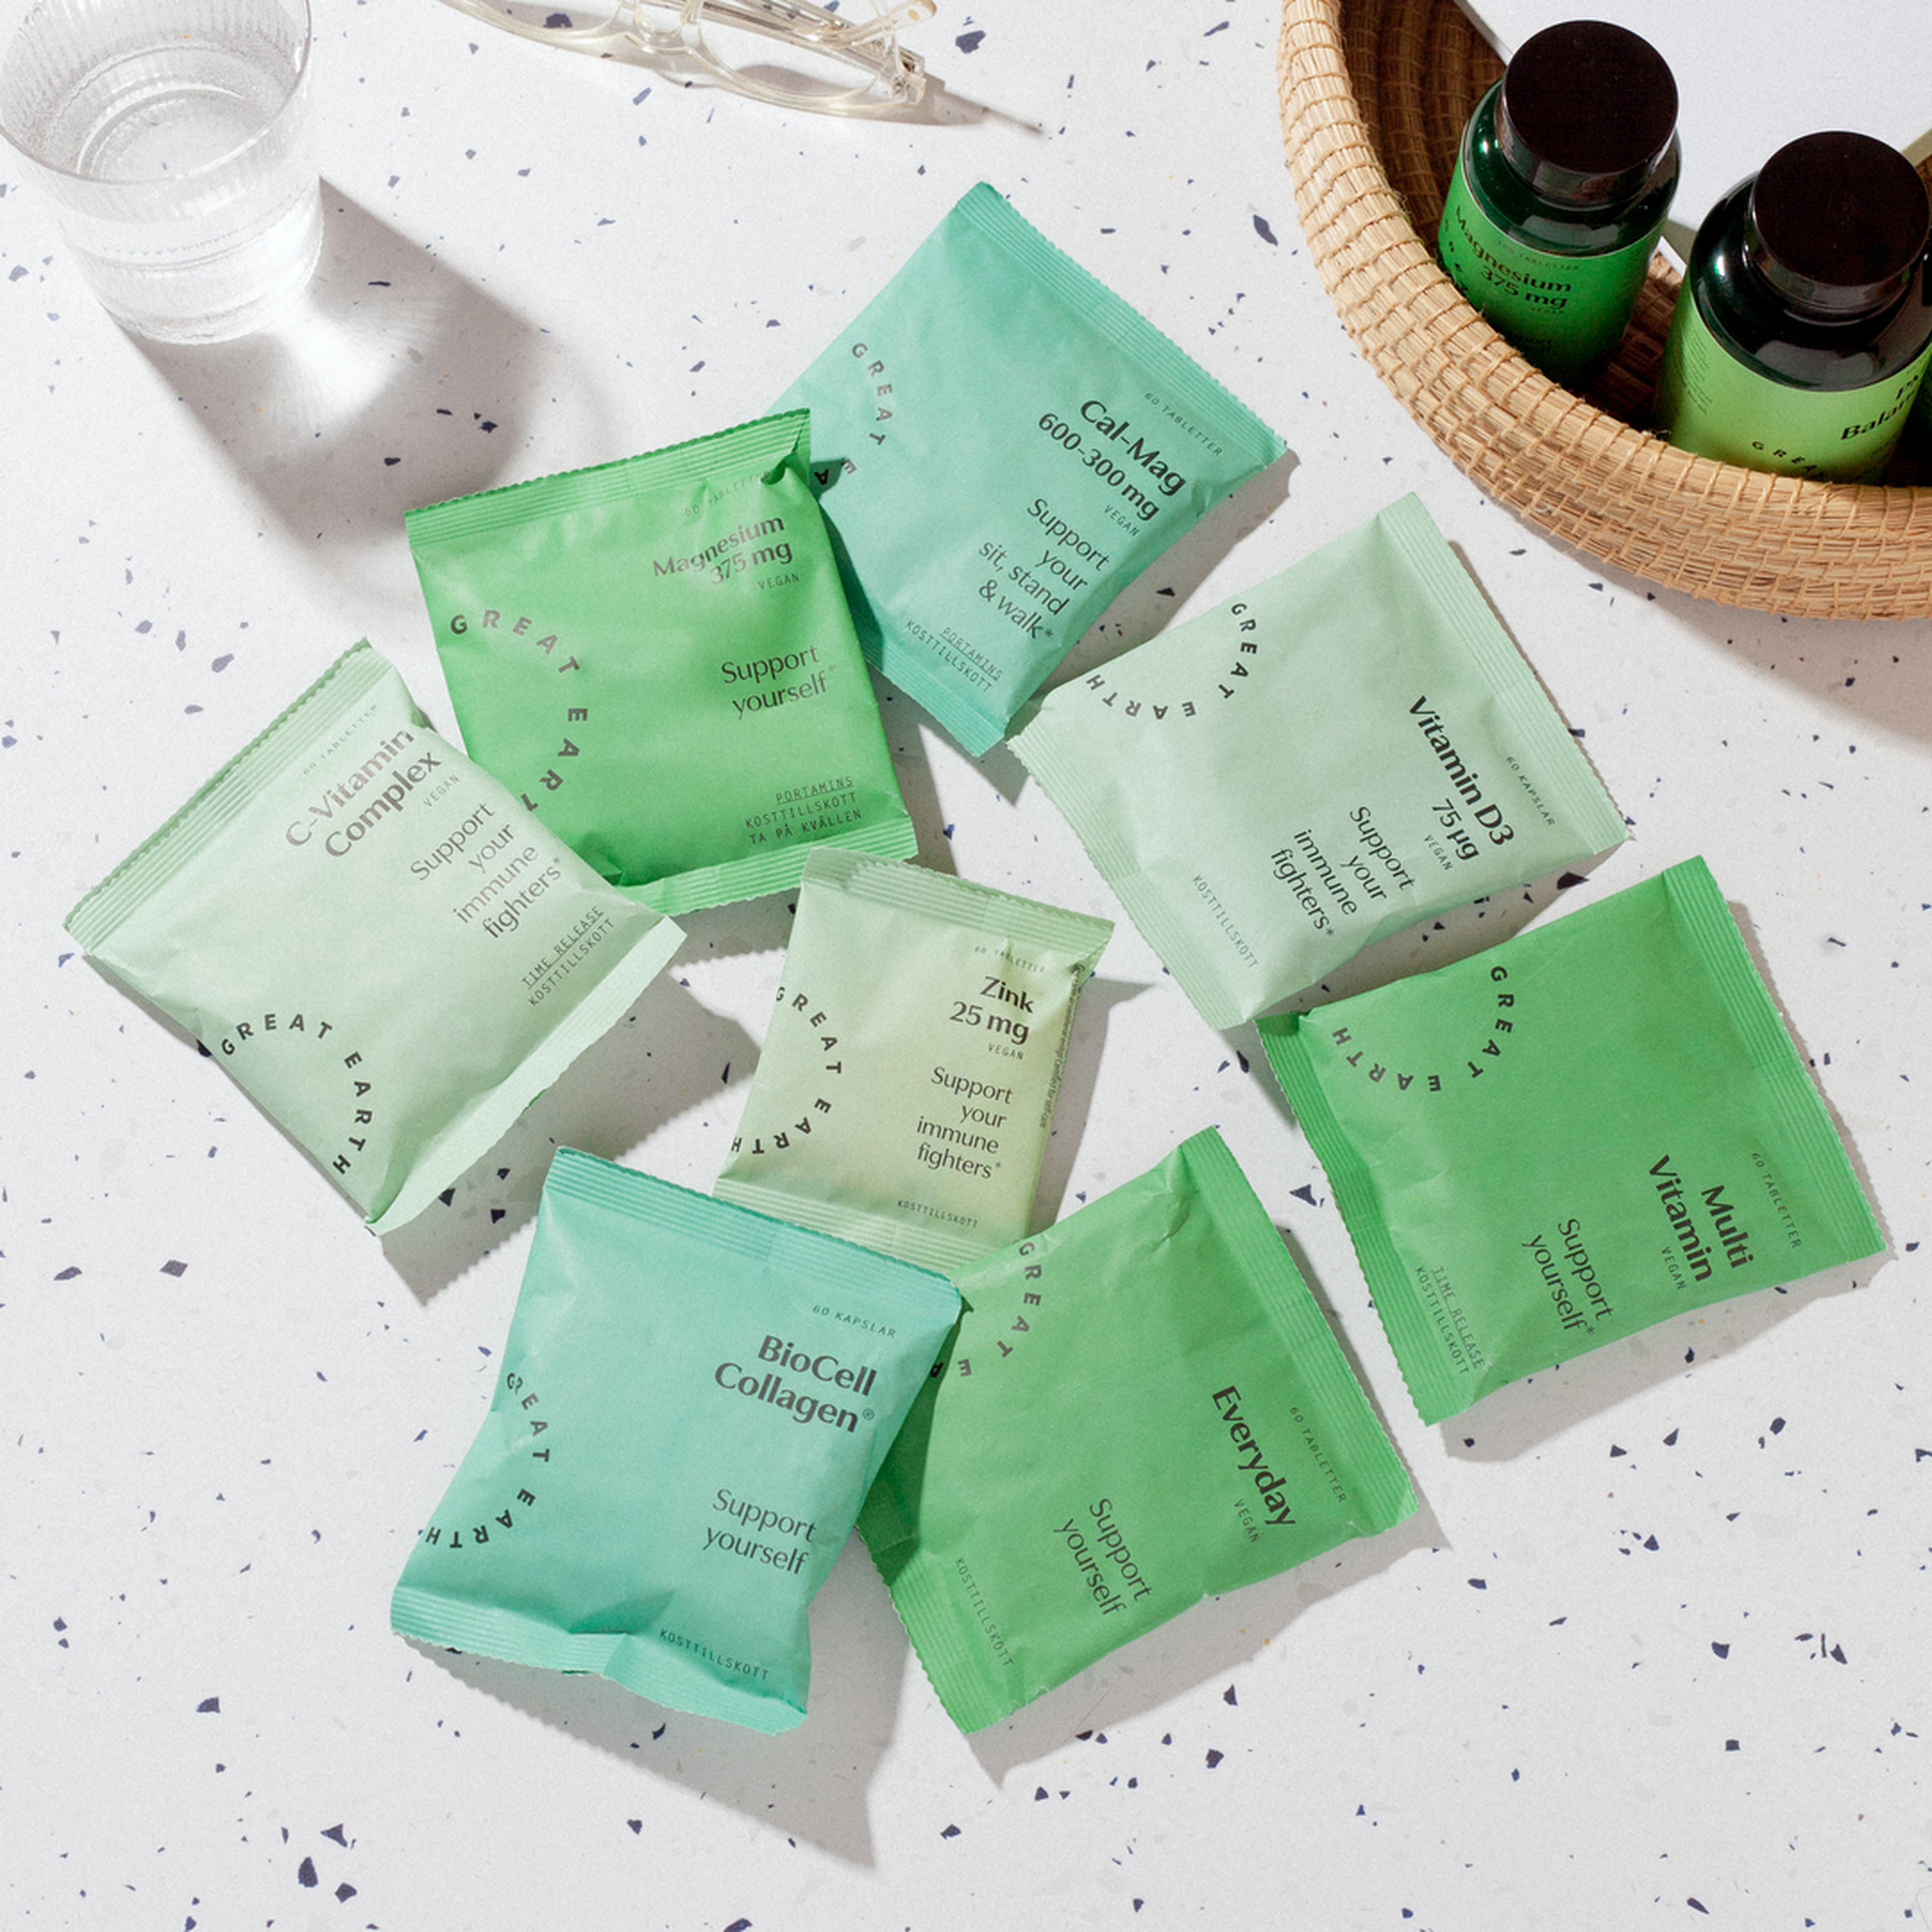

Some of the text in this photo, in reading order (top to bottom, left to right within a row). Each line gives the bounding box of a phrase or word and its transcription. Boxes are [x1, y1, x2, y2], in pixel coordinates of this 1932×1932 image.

[1456, 205, 1572, 292] Magnesium
[1481, 265, 1567, 309] 375 mg
[852, 343, 893, 445] GREAT
[1145, 393, 1223, 456] 60 TABLETTER
[1038, 413, 1159, 521] 600-300 mg
[1081, 400, 1186, 496] Cal-Mag
[1752, 441, 1817, 472] GREA
[685, 505, 700, 516] 60
[1027, 499, 1110, 571] Support
[1104, 505, 1140, 537] VEGAN
[653, 517, 784, 576] Magnesium
[710, 542, 793, 585] 375 mg
[1035, 550, 1088, 590] your
[758, 573, 799, 590] VEGAN
[979, 541, 1070, 615] sit, stand
[979, 579, 998, 601] &
[451, 610, 580, 673] GREAT
[721, 645, 820, 683] Support
[906, 621, 993, 693] KOSTTILLSKOTT
[940, 627, 1004, 681] PORTAMINS
[1218, 603, 1257, 699] GREAT
[1086, 674, 1196, 719] EARTH
[321, 704, 377, 759] TABLETTER
[521, 708, 587, 811] EART
[286, 730, 414, 845] C-Vitamin
[423, 774, 460, 807] VEGAN
[776, 776, 854, 805] PORTAMINS
[1409, 695, 1514, 845] Vitamin D3
[1506, 756, 1555, 826] 60 KAPSLAR
[326, 752, 441, 856] Complex
[746, 792, 856, 829] KOSTTILLSKOTT
[749, 809, 861, 844] TA PÅ KVÄLLEN
[1432, 798, 1480, 860] 75 µg
[410, 802, 496, 880] Support
[469, 825, 514, 873] your
[1294, 829, 1357, 915] immune
[1350, 806, 1415, 891] Support
[1424, 835, 1453, 870] VEGAN
[453, 846, 539, 923] immune
[1340, 855, 1387, 900] your
[521, 907, 604, 990] TIME RELEASE
[1193, 874, 1259, 969] KOSTTILLSKOTT
[528, 918, 614, 1006] KOSTTILLSKOTT
[950, 1001, 1029, 1045] 25 mg
[980, 976, 1034, 1013] Zink
[1468, 966, 1514, 1078] GREAT
[222, 1014, 333, 1055] GREAT
[776, 987, 842, 1074] GREAT
[988, 1042, 1023, 1060] VEGAN
[1332, 1027, 1441, 1092] EARTH
[333, 1052, 372, 1174] EARTH
[931, 1067, 1013, 1104] Support
[960, 1105, 1007, 1128] your
[731, 1098, 832, 1154] EARTH
[917, 1116, 999, 1154] immune
[898, 1200, 978, 1228] KOSTTILLSKOTT
[1649, 1154, 1712, 1281] Vitamin
[1701, 1185, 1754, 1268] Multi
[1751, 1153, 1802, 1249] 60 TABLETTER
[1558, 1219, 1614, 1321] Support
[1661, 1246, 1686, 1290] VEGAN
[813, 1305, 896, 1338] 60 KAPSLAR
[997, 1242, 1041, 1357] GREAT
[1416, 1266, 1469, 1375] KOSTTILLSKOTT
[1431, 1267, 1485, 1370] TIME RELEASE
[758, 1335, 877, 1396] BioCell
[1213, 1386, 1296, 1525] Everyday
[1290, 1407, 1347, 1503] 60 TABLETTER
[426, 1489, 535, 1548] EARTH
[713, 1489, 817, 1543] Support
[1235, 1498, 1260, 1543] VEGAN
[703, 1527, 809, 1574] yourself
[1054, 1518, 1127, 1615] yourself
[1089, 1498, 1152, 1601] Support
[955, 1558, 1014, 1667] KOSTTILLSKOTT
[660, 1629, 769, 1680] KOSTTILLSKOTT
